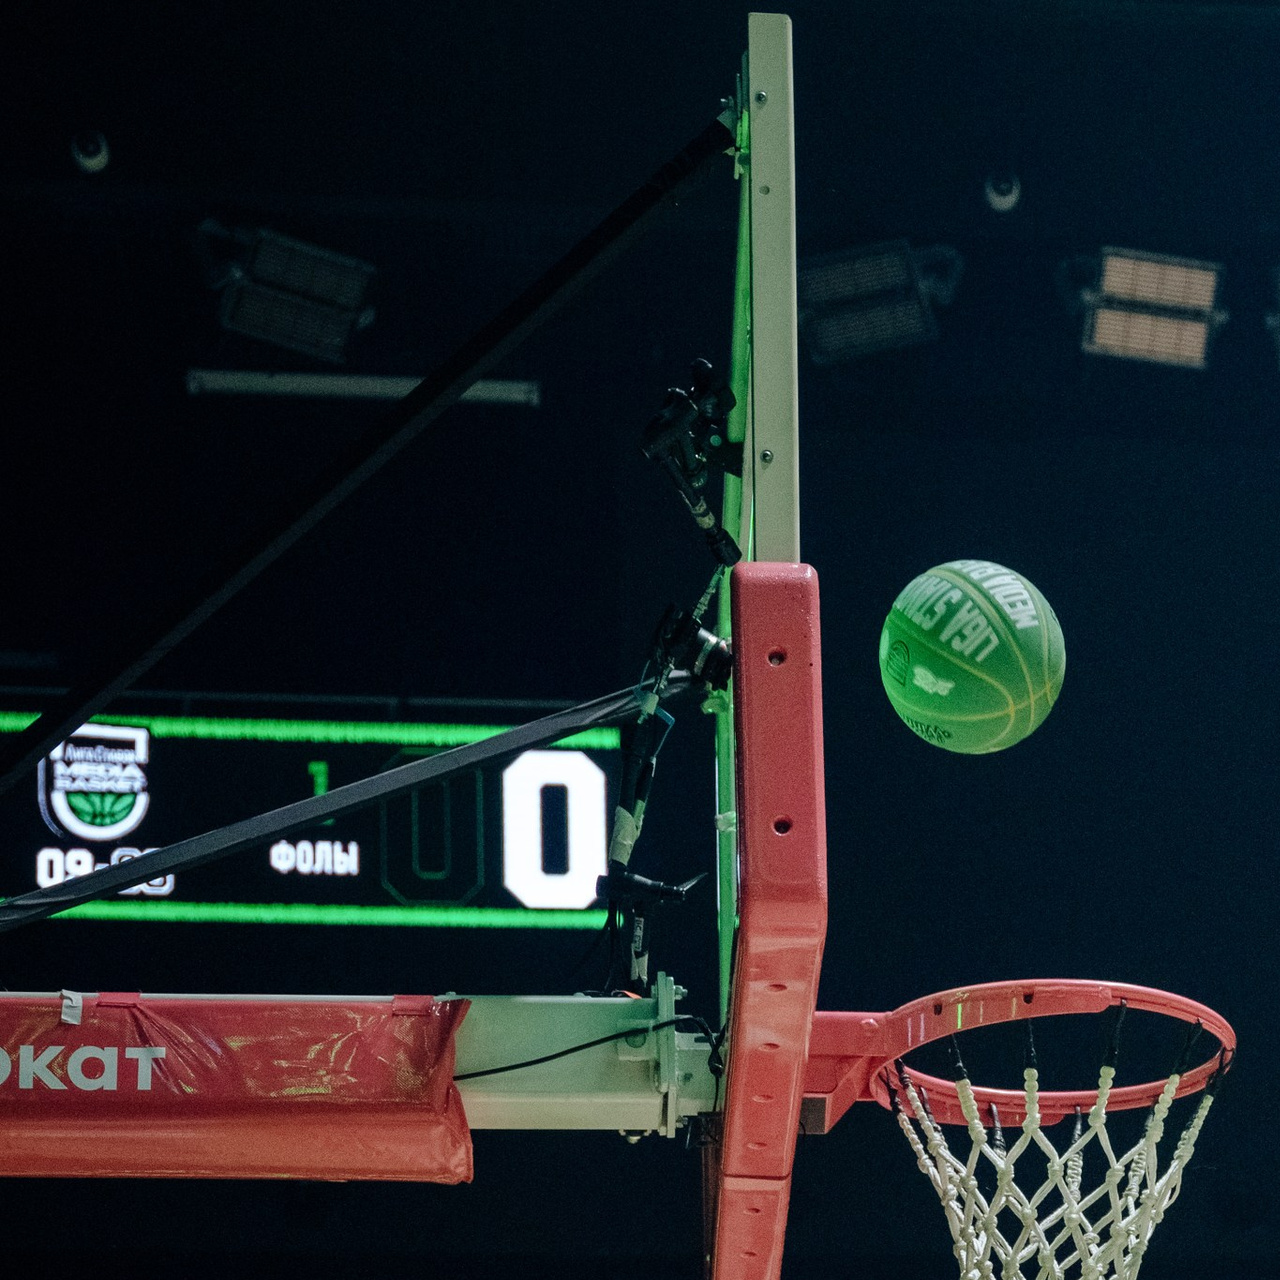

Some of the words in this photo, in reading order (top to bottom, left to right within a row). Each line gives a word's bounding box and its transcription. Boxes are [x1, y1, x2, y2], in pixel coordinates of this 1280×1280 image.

[939, 599, 1000, 663] LIGA
[502, 749, 608, 909] 0
[269, 839, 359, 876] ФОЛЫ
[0, 1043, 166, 1091] кат
